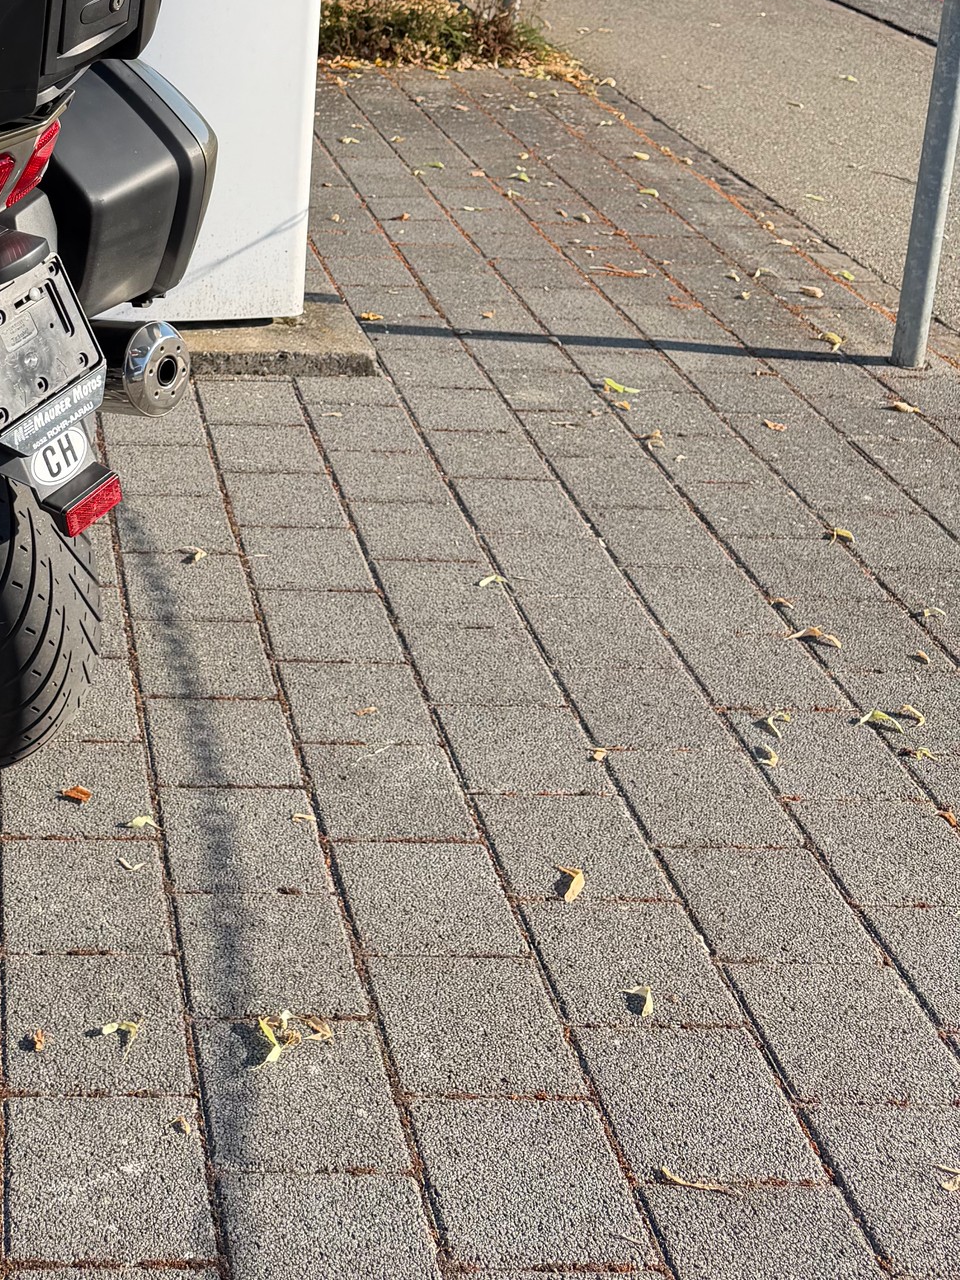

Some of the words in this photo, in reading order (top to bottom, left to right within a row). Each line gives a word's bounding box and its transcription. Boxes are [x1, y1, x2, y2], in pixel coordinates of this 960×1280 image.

[72, 374, 102, 404] MOTOS
[46, 401, 94, 440] ROHR-AARAU
[42, 432, 79, 478] CH
